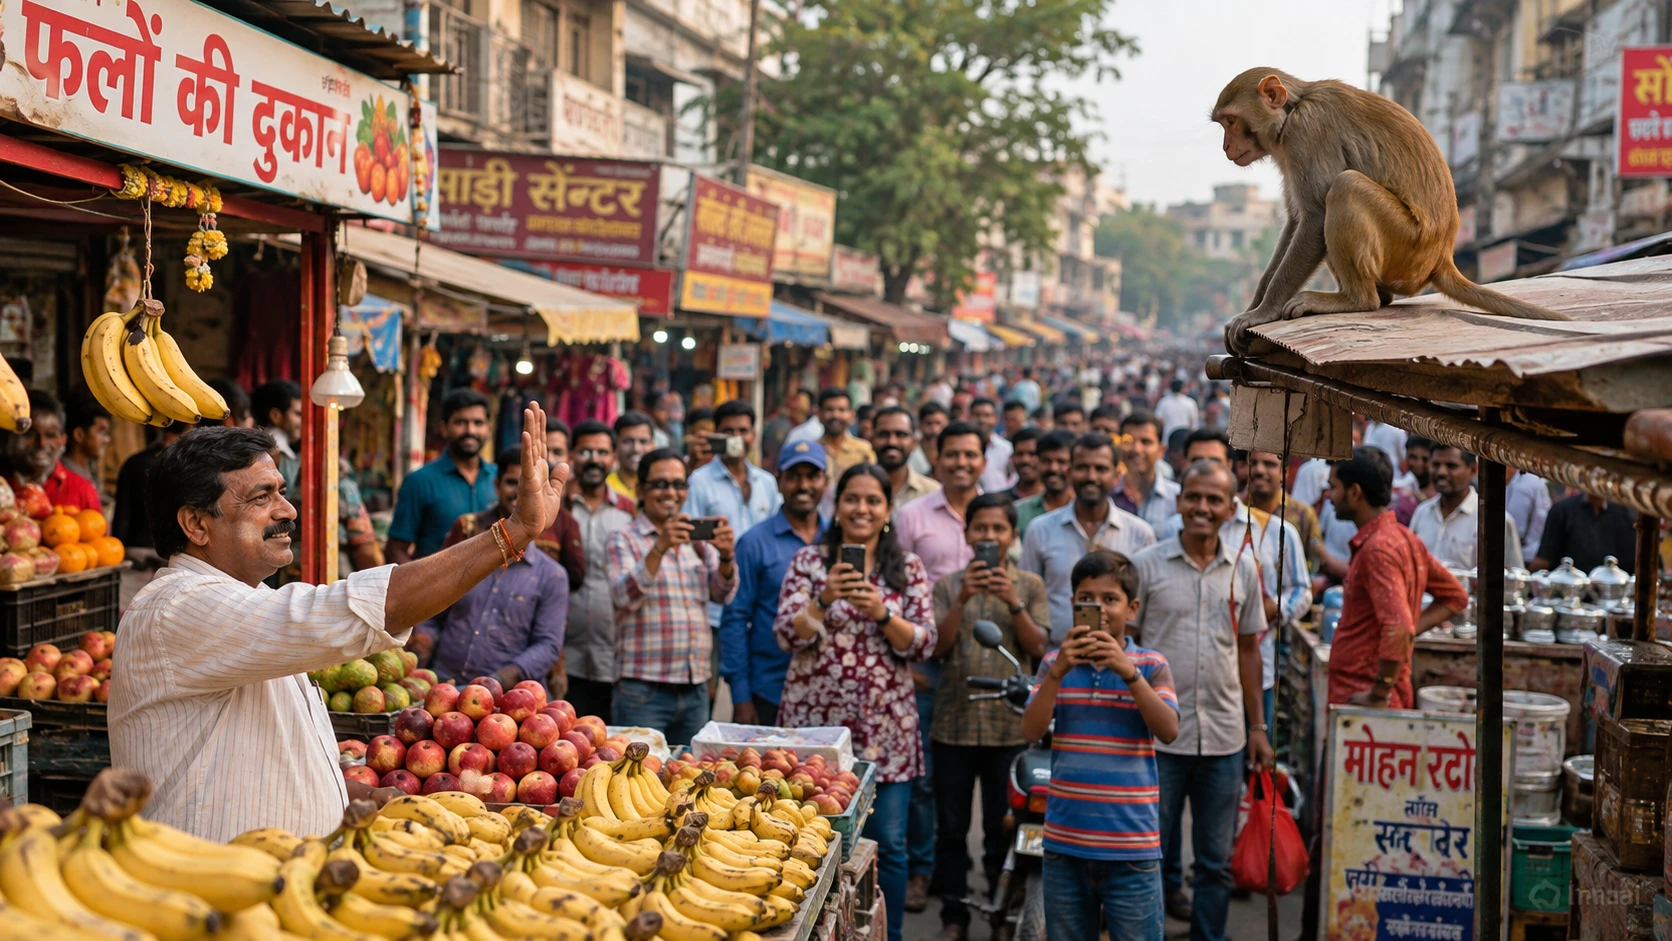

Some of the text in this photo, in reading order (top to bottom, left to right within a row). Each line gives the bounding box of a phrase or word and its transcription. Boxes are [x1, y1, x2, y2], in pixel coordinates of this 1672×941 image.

[22, 0, 351, 183] फलों की दुकान
[1343, 724, 1476, 791] मोहन रटो
